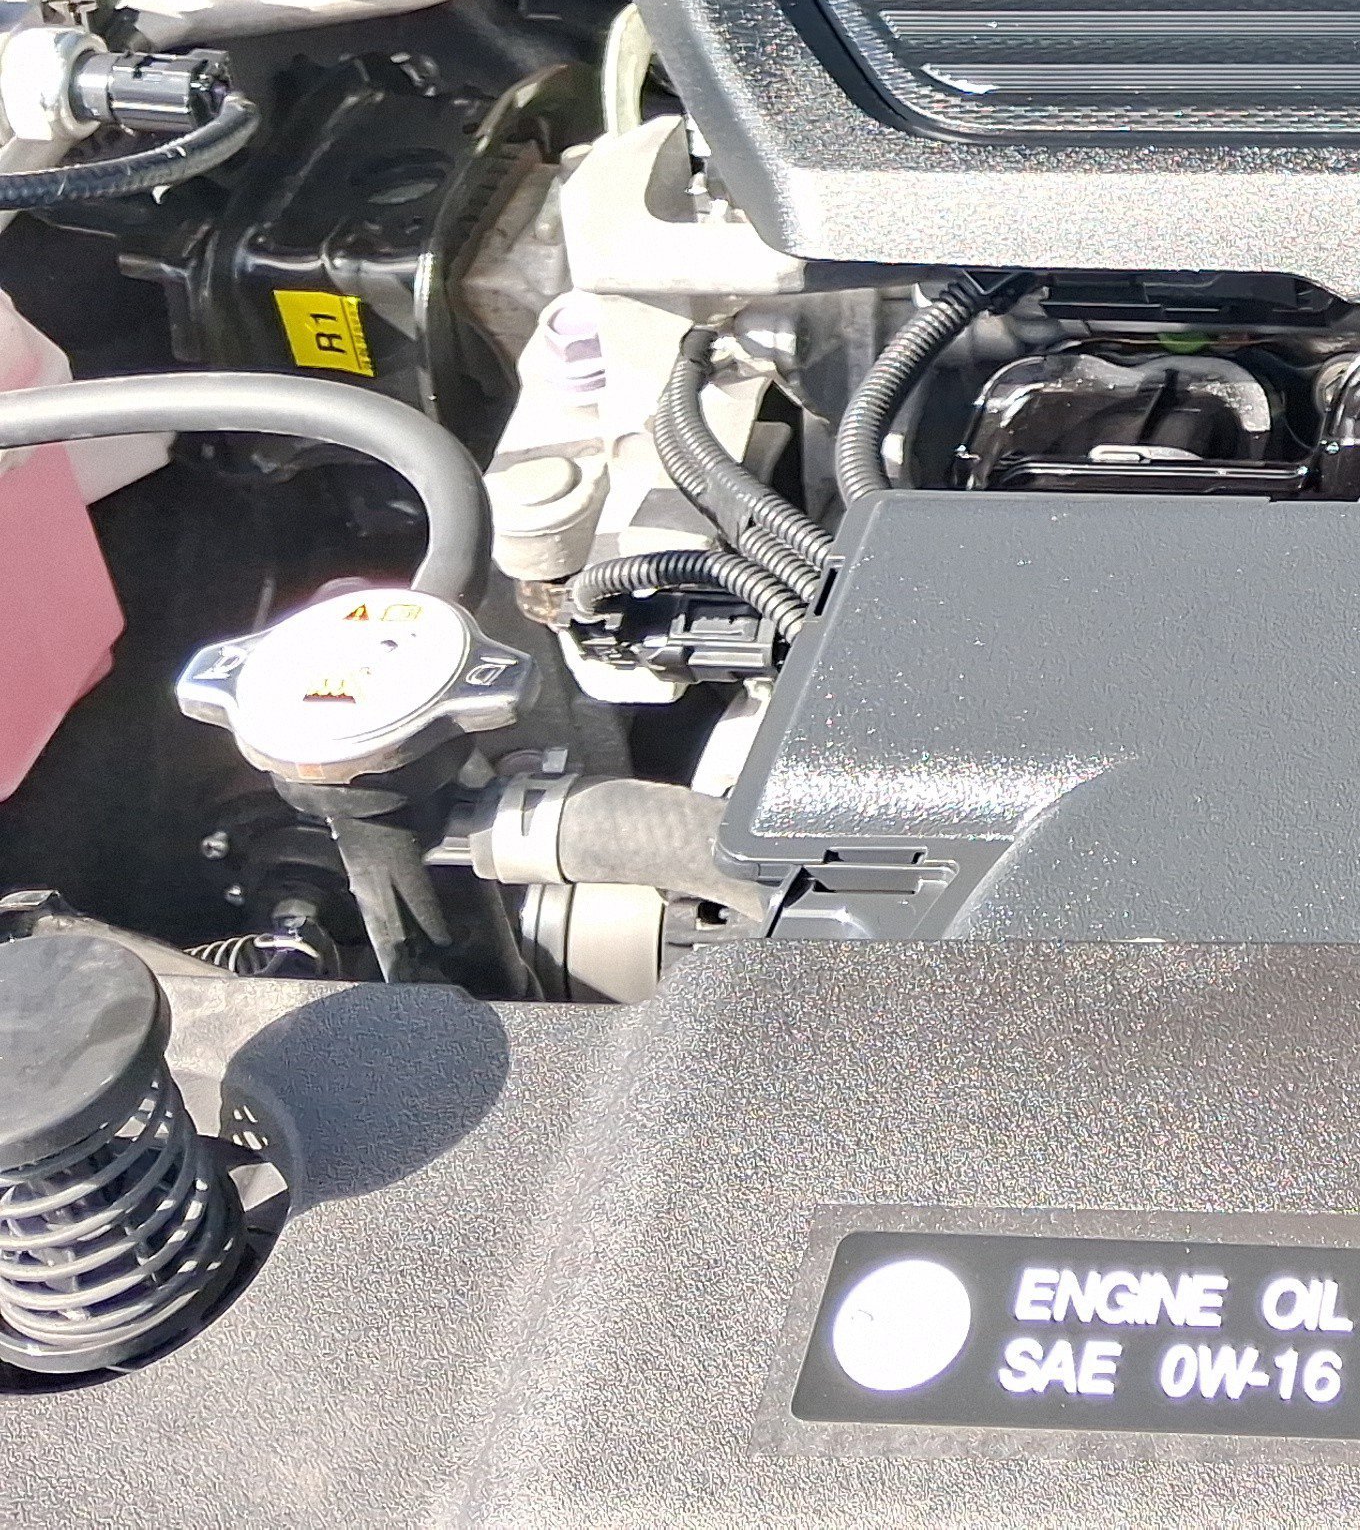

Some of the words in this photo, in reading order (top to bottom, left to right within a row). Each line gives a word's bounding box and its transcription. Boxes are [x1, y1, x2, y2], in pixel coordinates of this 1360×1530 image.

[1014, 1269, 1230, 1326] ENGINE
[1260, 1278, 1354, 1332] OIL
[999, 1339, 1121, 1397] SAE
[1158, 1344, 1344, 1403] 0W-16
